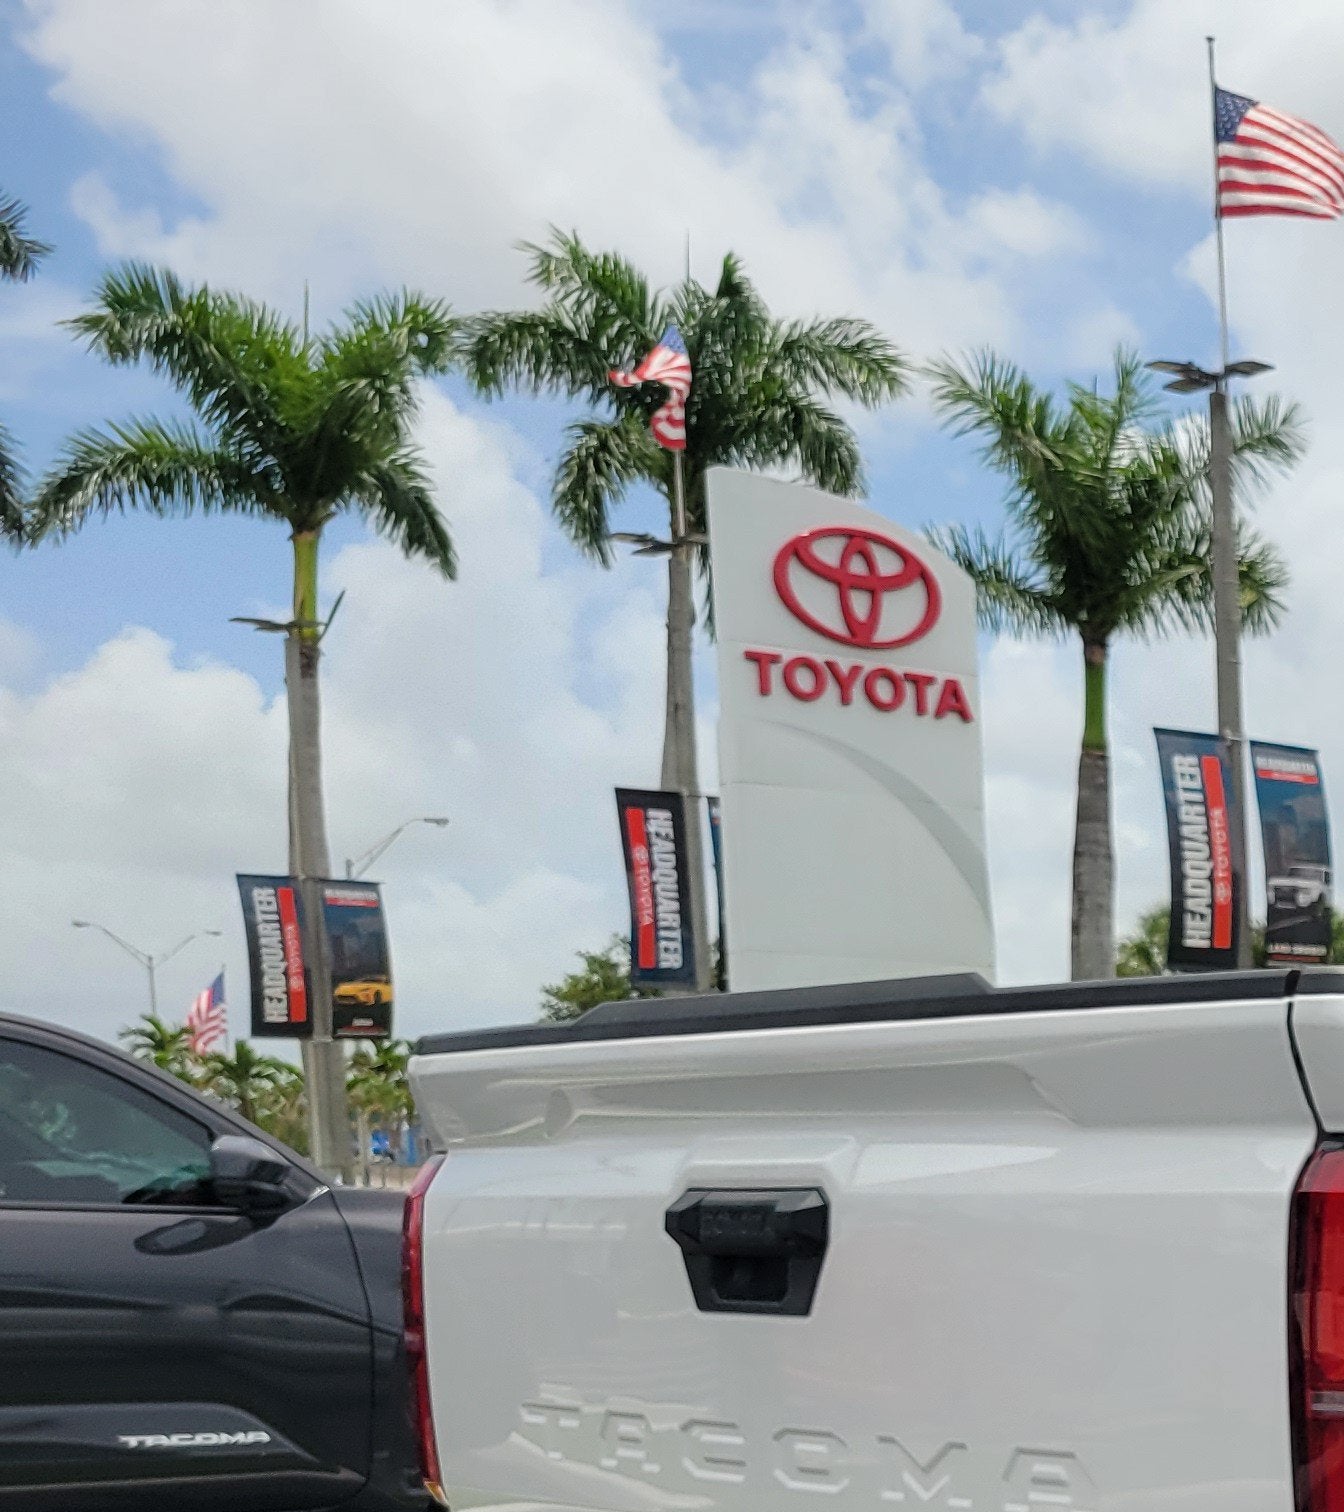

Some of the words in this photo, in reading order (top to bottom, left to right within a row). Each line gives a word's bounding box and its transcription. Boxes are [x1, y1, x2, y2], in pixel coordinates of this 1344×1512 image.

[744, 650, 974, 724] TOYOTA
[1173, 755, 1213, 948] HEADQUARTER
[1209, 807, 1231, 877] TOYOTA
[637, 867, 654, 925] TOYOTA
[646, 807, 683, 969] HEADQUARTER
[252, 886, 288, 1023] HEADQUARTER
[118, 1431, 271, 1449] TACOMA
